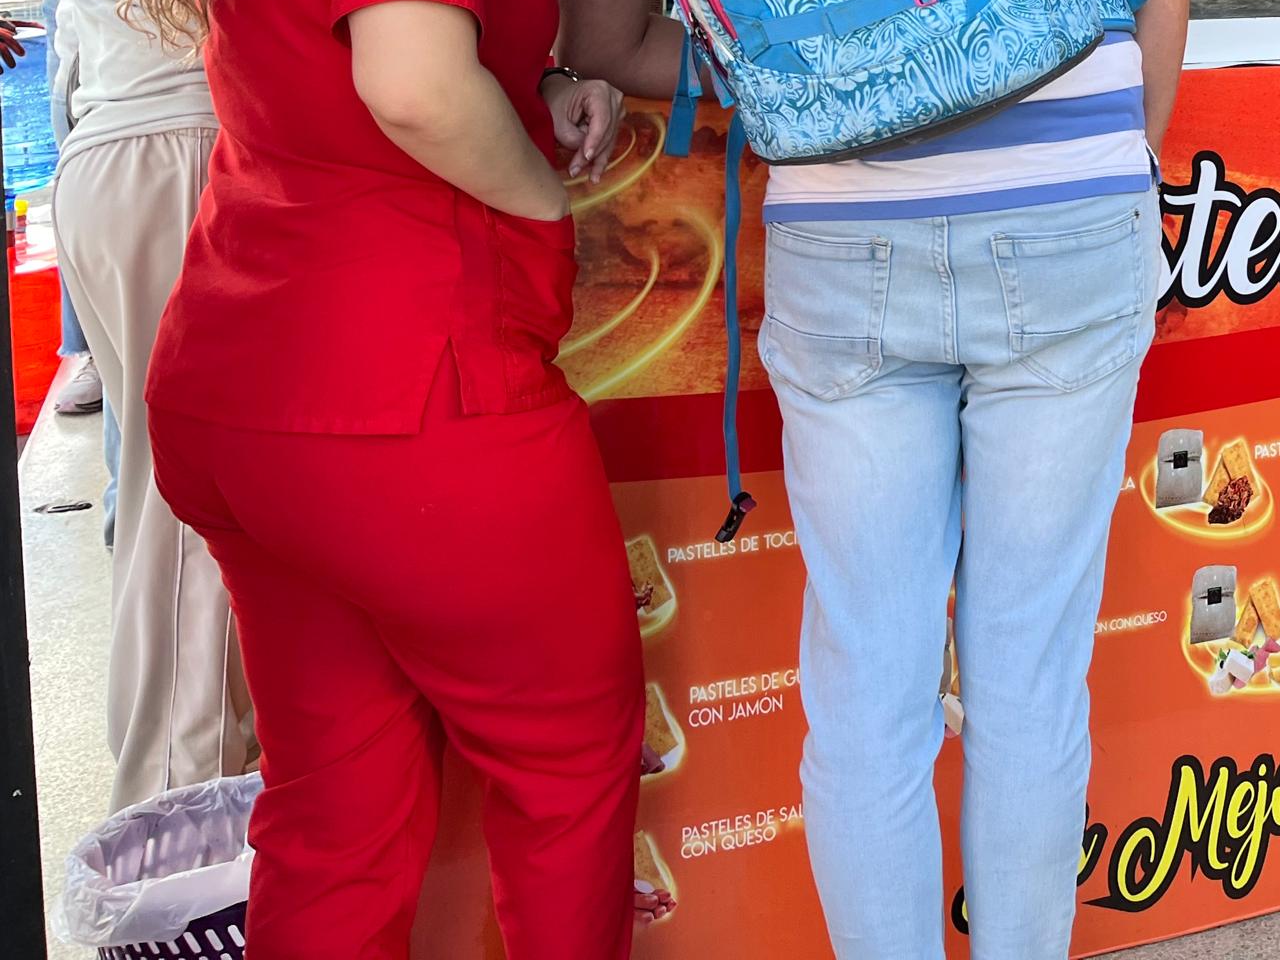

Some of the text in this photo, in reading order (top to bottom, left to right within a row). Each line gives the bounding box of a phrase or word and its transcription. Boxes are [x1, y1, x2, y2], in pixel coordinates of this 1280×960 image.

[667, 530, 797, 563] PASTELES DE TOCI
[1109, 617, 1132, 631] CON
[1133, 610, 1168, 627] QUESO
[689, 676, 757, 704] PASTELES
[761, 671, 780, 691] DE
[688, 691, 783, 728] CON JAMÓN
[682, 803, 803, 842] PASTELES DE SAL
[680, 826, 777, 859] CON QUESO
